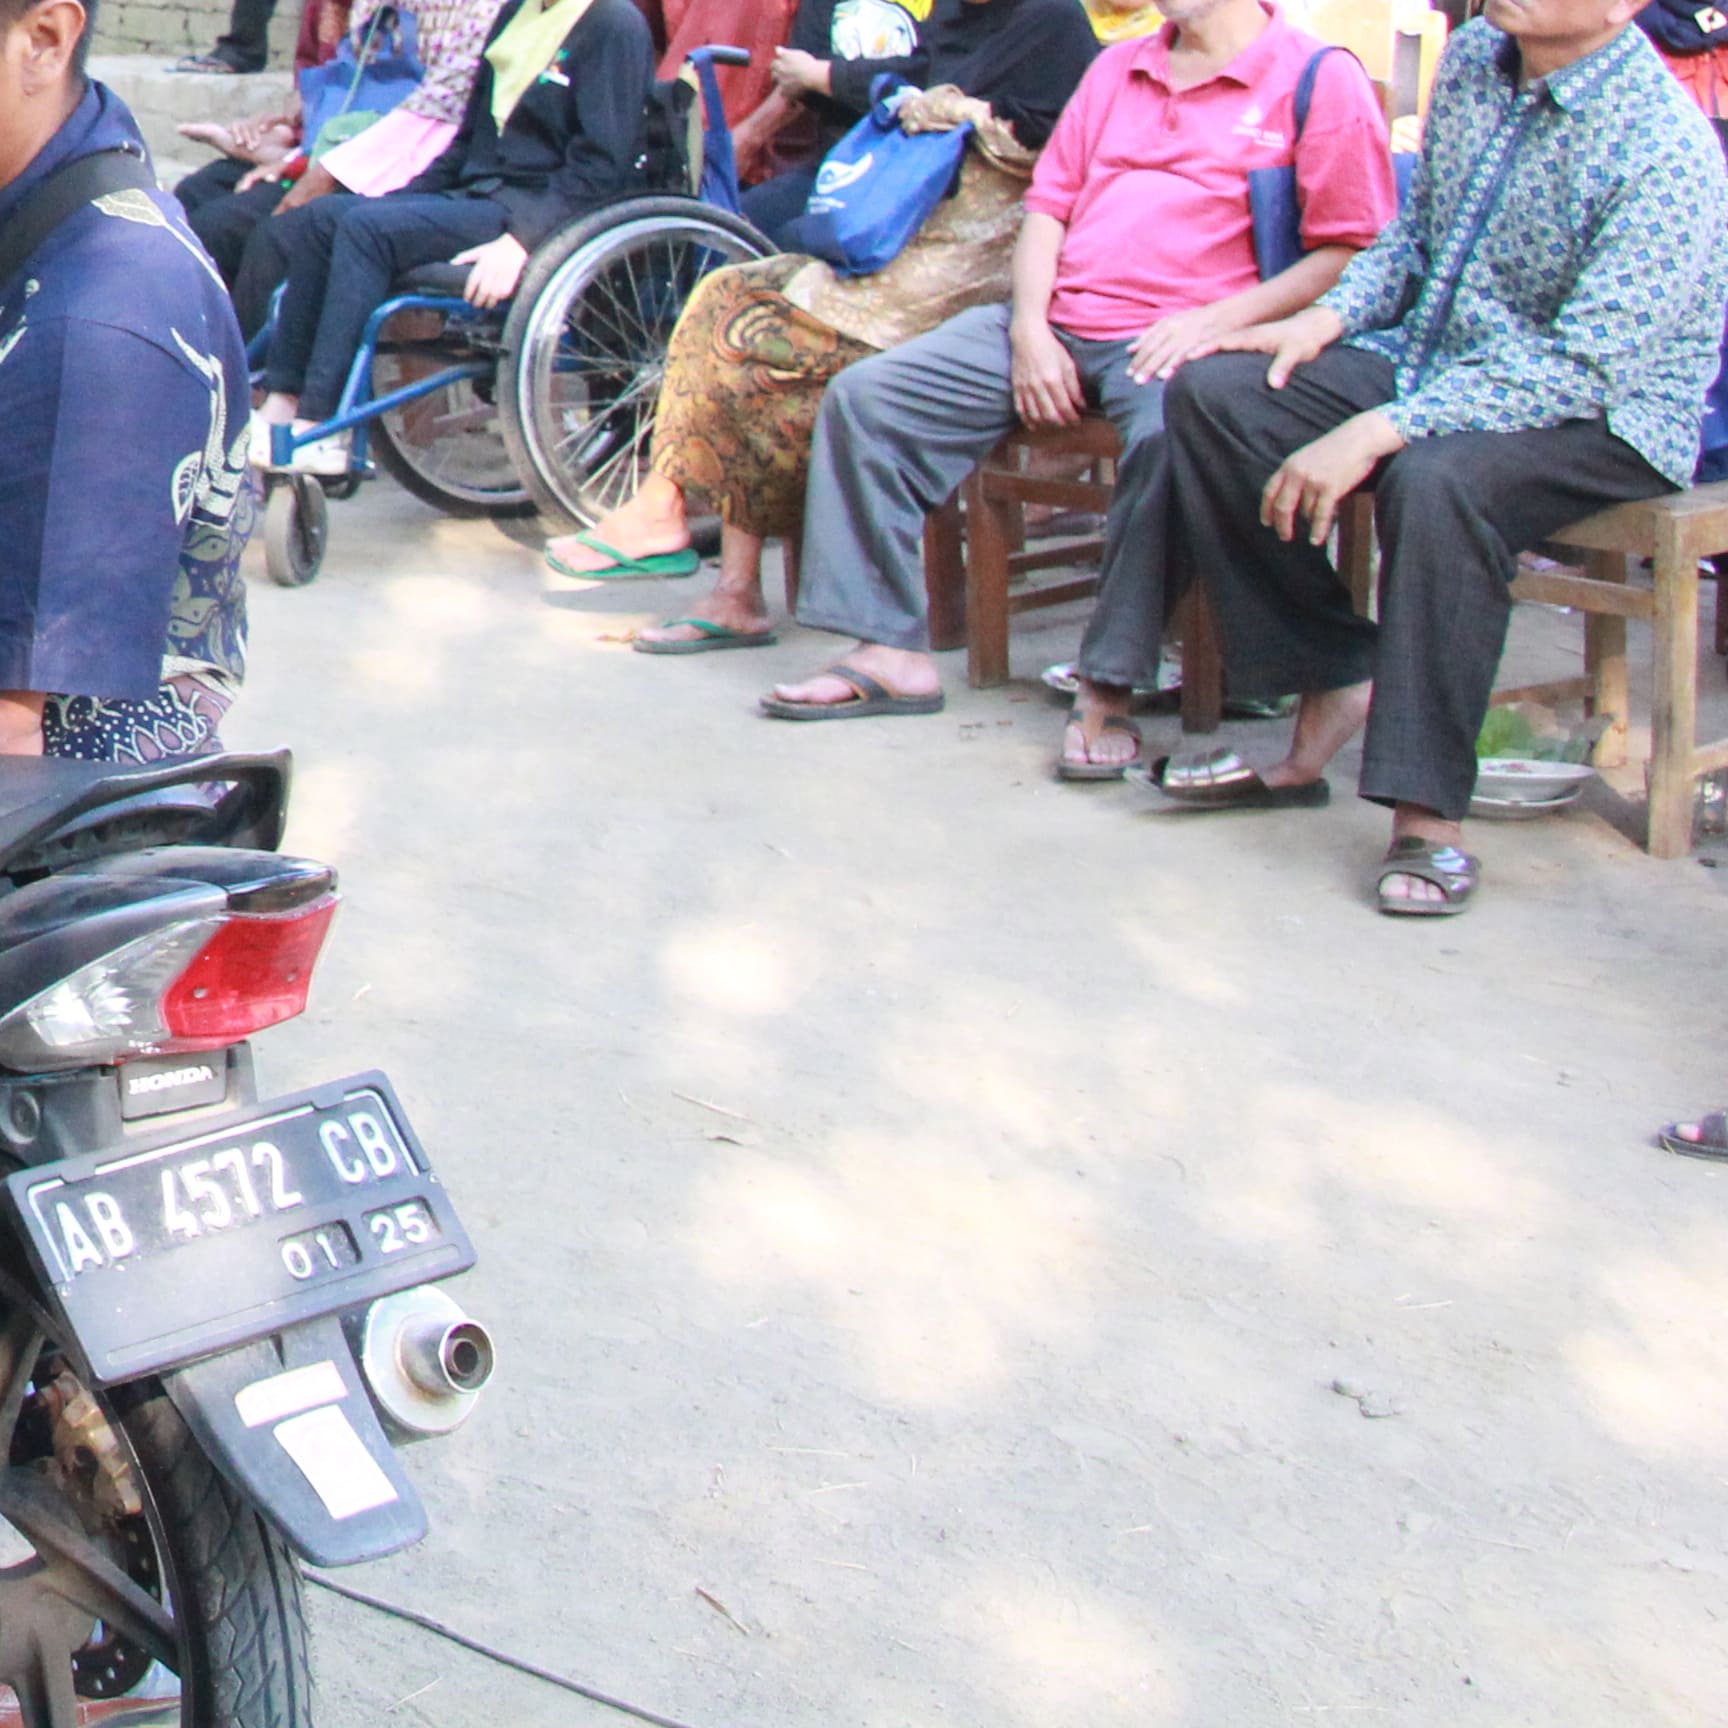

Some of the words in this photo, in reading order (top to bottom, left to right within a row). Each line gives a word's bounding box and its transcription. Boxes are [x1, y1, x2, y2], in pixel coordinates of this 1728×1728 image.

[128, 1065, 215, 1095] HONDA
[55, 1192, 135, 1272] AB
[160, 1141, 304, 1238] 4572
[318, 1112, 397, 1184] CB
[281, 1233, 342, 1280] 01
[369, 1205, 431, 1254] 25
